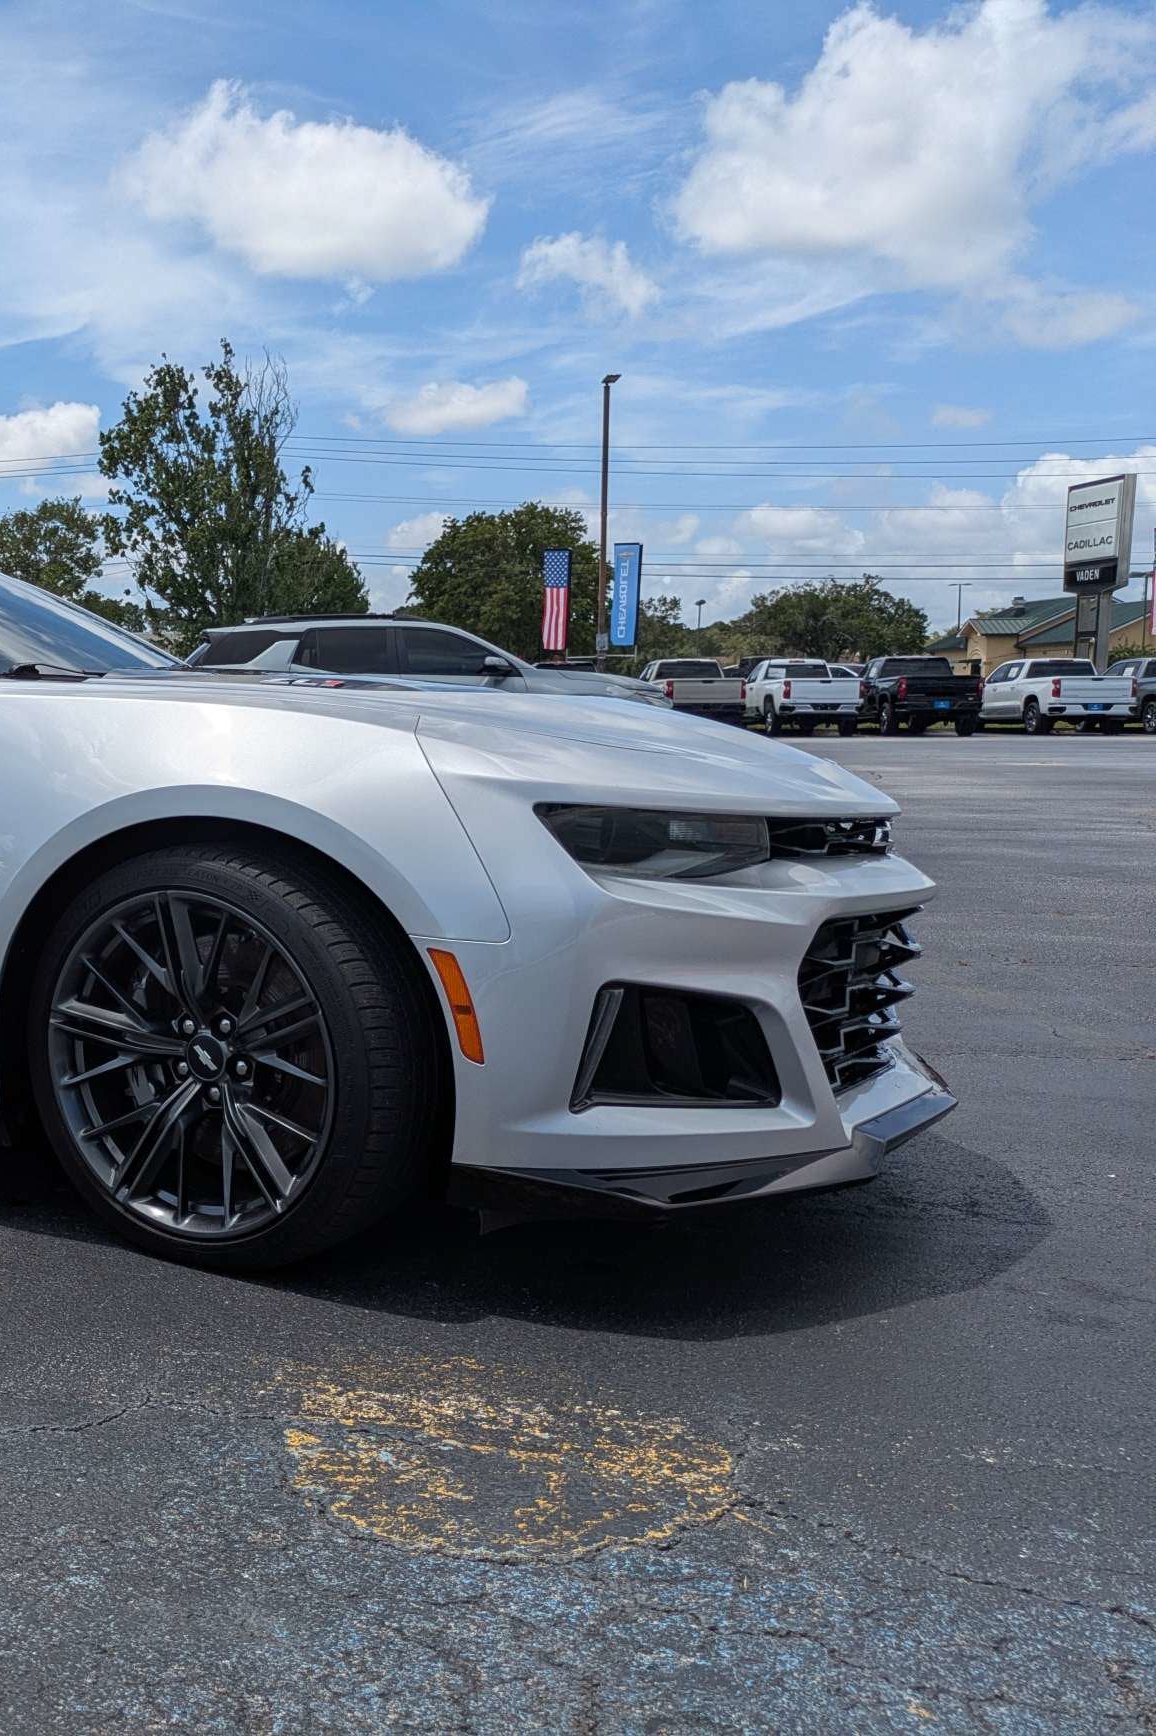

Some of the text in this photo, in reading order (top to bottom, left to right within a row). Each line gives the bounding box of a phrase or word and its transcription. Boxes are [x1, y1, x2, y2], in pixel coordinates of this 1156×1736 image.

[1069, 497, 1116, 512] CHEVROLET
[1067, 535, 1113, 551] CADILLAC
[1076, 568, 1100, 582] VADEN
[617, 560, 629, 638] CHEVROLET
